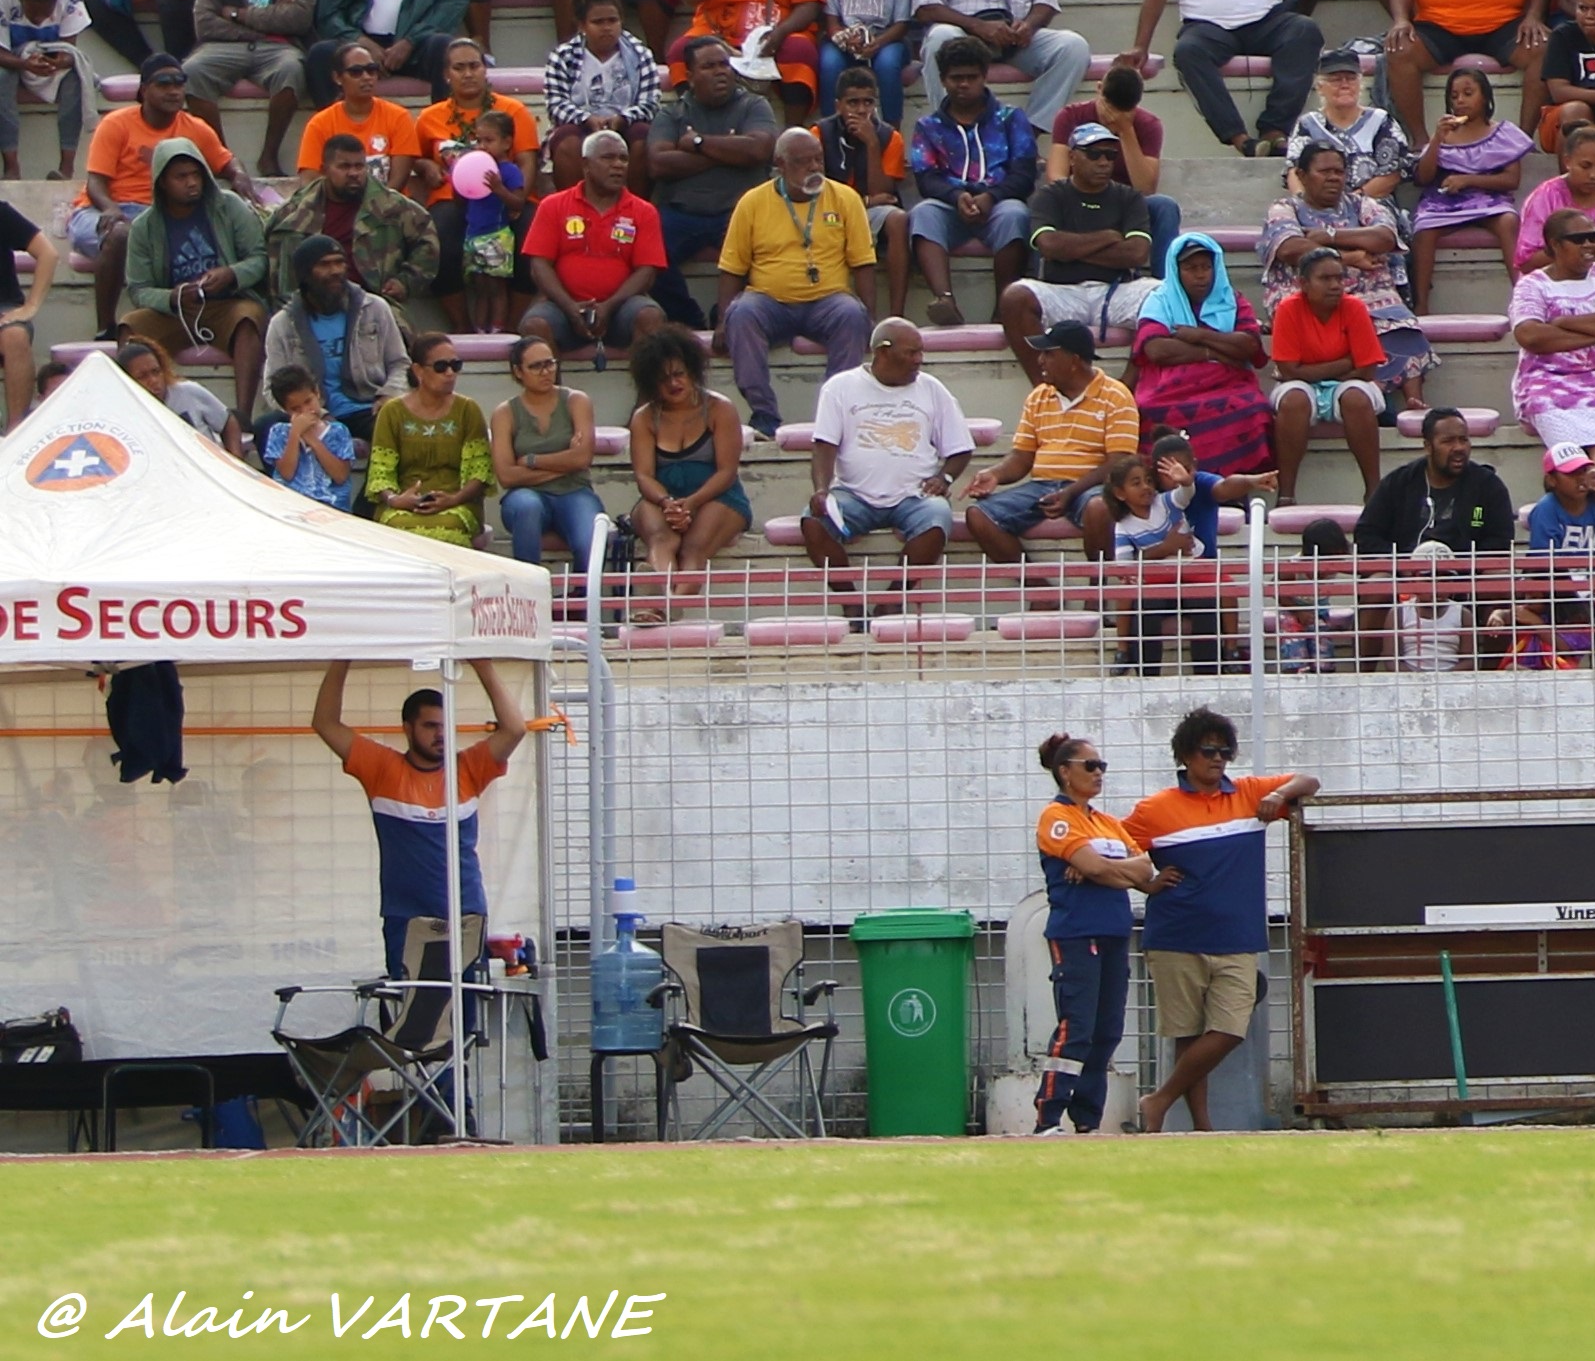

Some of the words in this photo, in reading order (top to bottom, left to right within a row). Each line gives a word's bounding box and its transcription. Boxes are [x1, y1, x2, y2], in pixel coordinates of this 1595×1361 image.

[15, 420, 107, 468] PROTECTION
[108, 420, 146, 457] CIVILE
[57, 586, 308, 640] SECOURS
